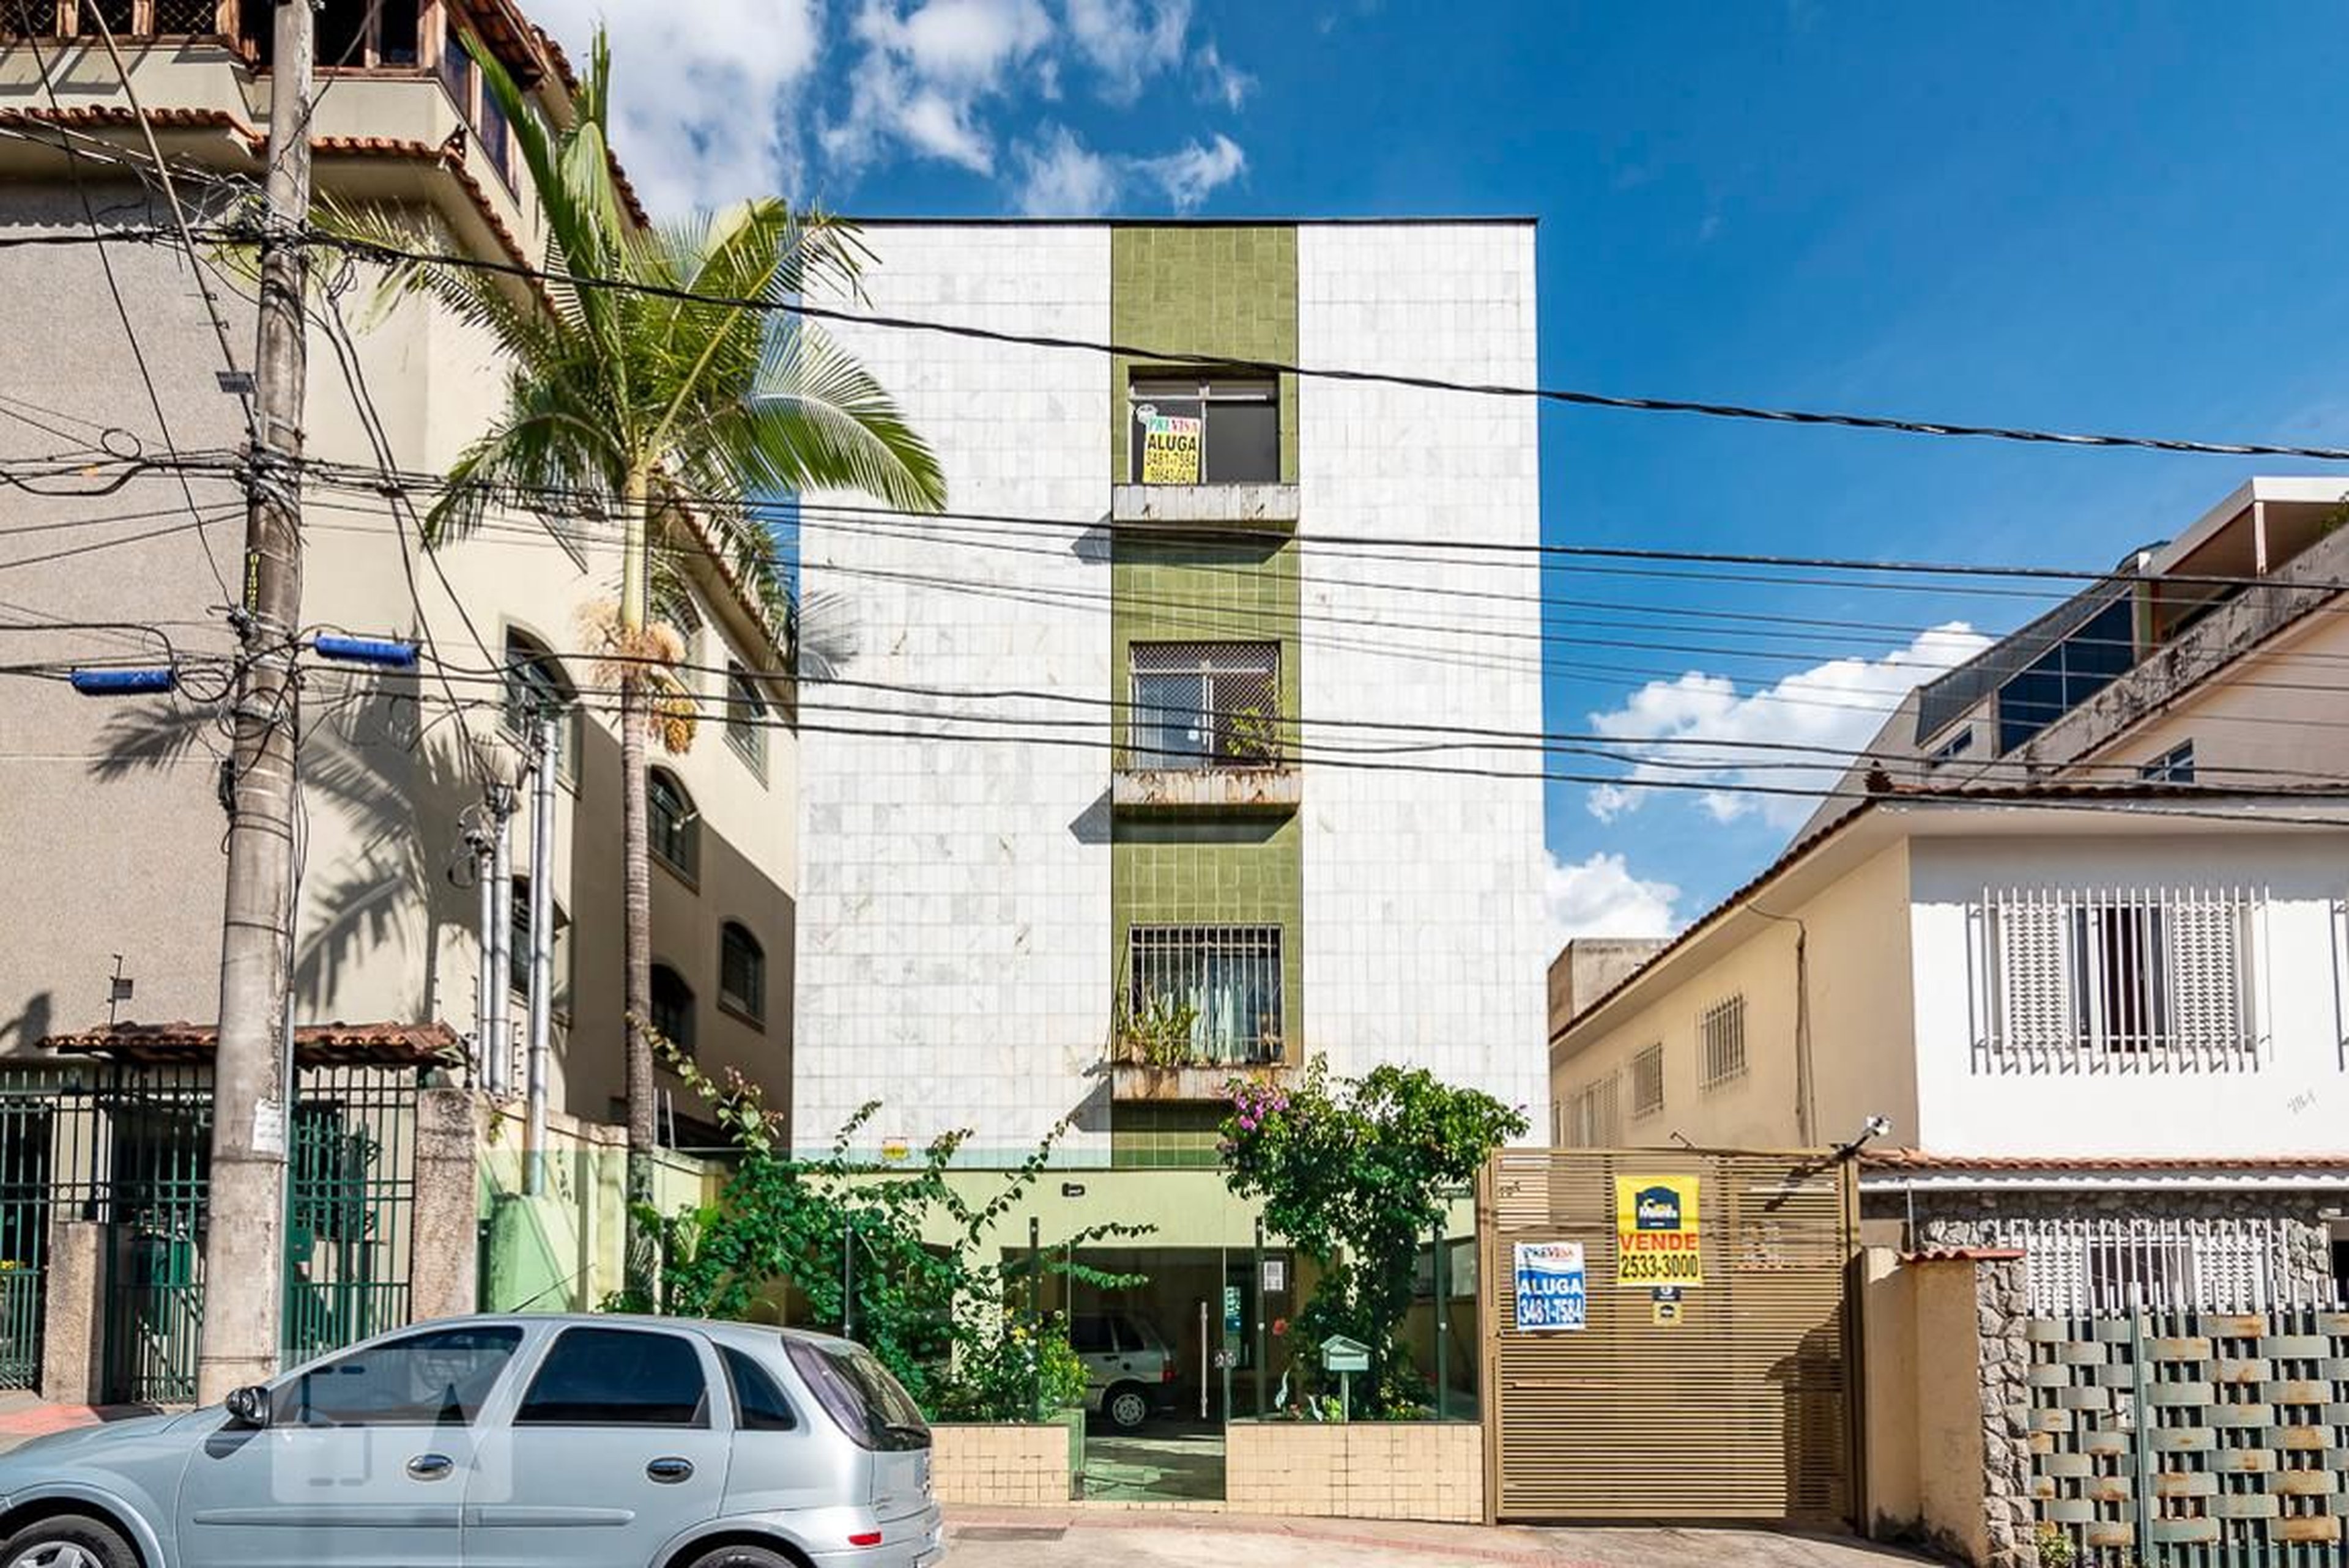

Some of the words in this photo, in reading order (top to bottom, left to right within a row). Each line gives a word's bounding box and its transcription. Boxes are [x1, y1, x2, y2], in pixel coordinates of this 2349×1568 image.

[1148, 434, 1197, 452] ALUGA
[1619, 1233, 1699, 1251] VENDE
[1620, 1254, 1699, 1278] 2533-3000
[1518, 1278, 1583, 1295] ALUGA
